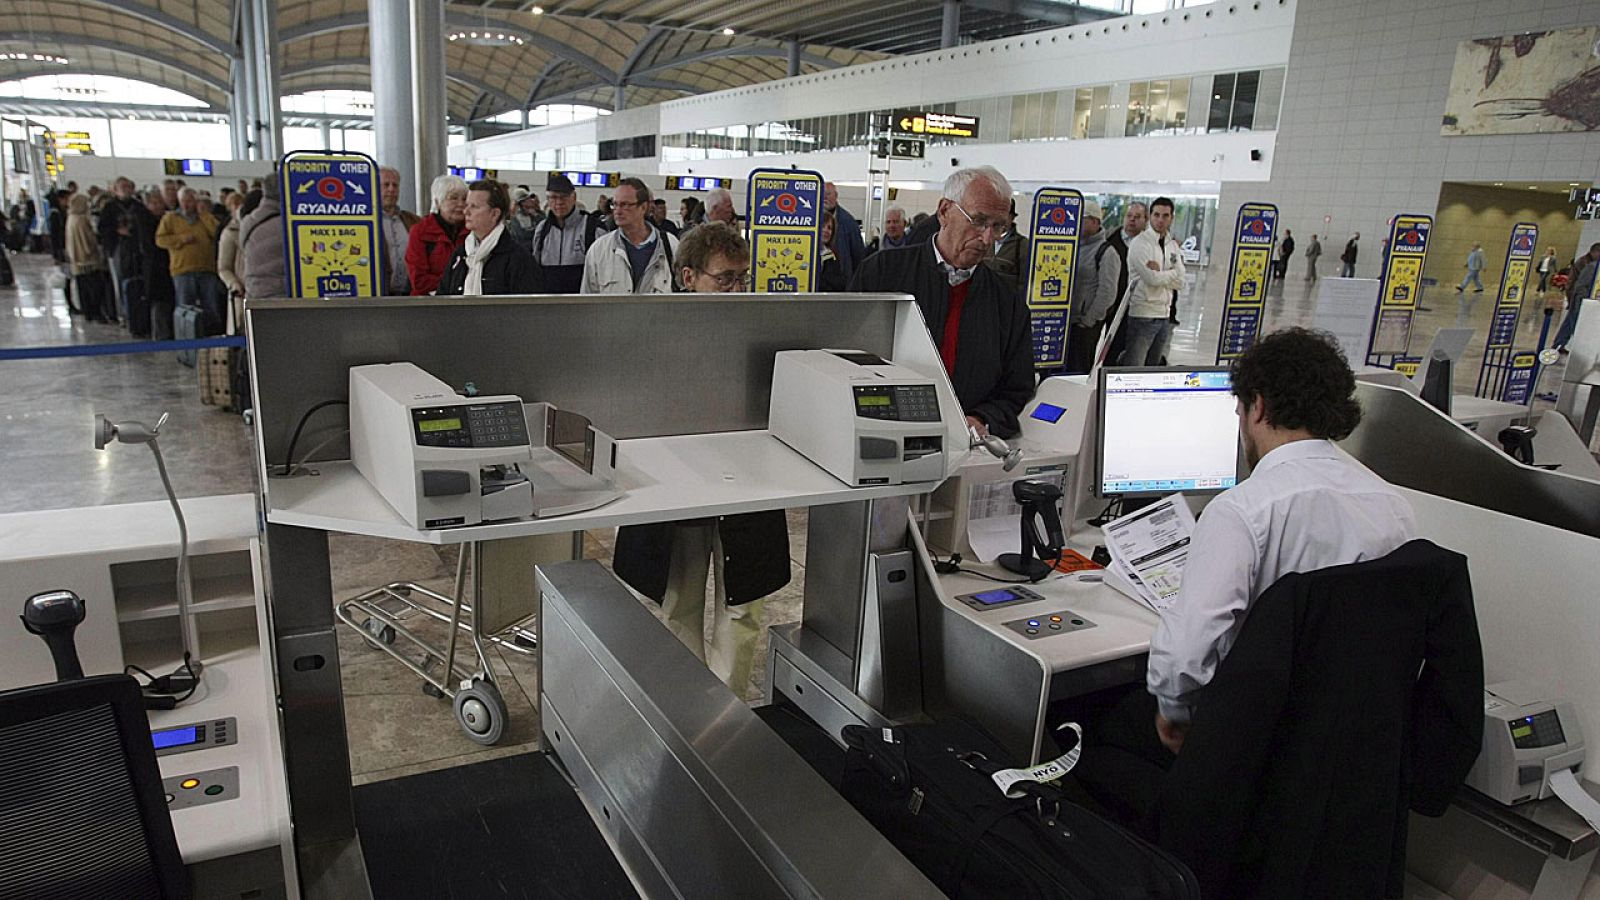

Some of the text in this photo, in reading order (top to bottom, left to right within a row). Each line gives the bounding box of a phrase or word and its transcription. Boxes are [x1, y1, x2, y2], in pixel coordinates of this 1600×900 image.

[290, 161, 369, 174] PRIORITY OTHER
[317, 176, 346, 202] Q
[757, 180, 817, 191] PRIORITY OTHER
[776, 193, 798, 215] Q
[1040, 196, 1080, 206] PRIORITY OTHER
[297, 203, 368, 214] RYANAIR
[758, 215, 812, 226] RYANAIR
[1052, 207, 1067, 226] Q
[310, 228, 357, 236] MAX 1 BAG
[1038, 226, 1075, 236] RYANAIR
[1241, 235, 1270, 243] RYANAIR
[1033, 764, 1059, 779] NYO
